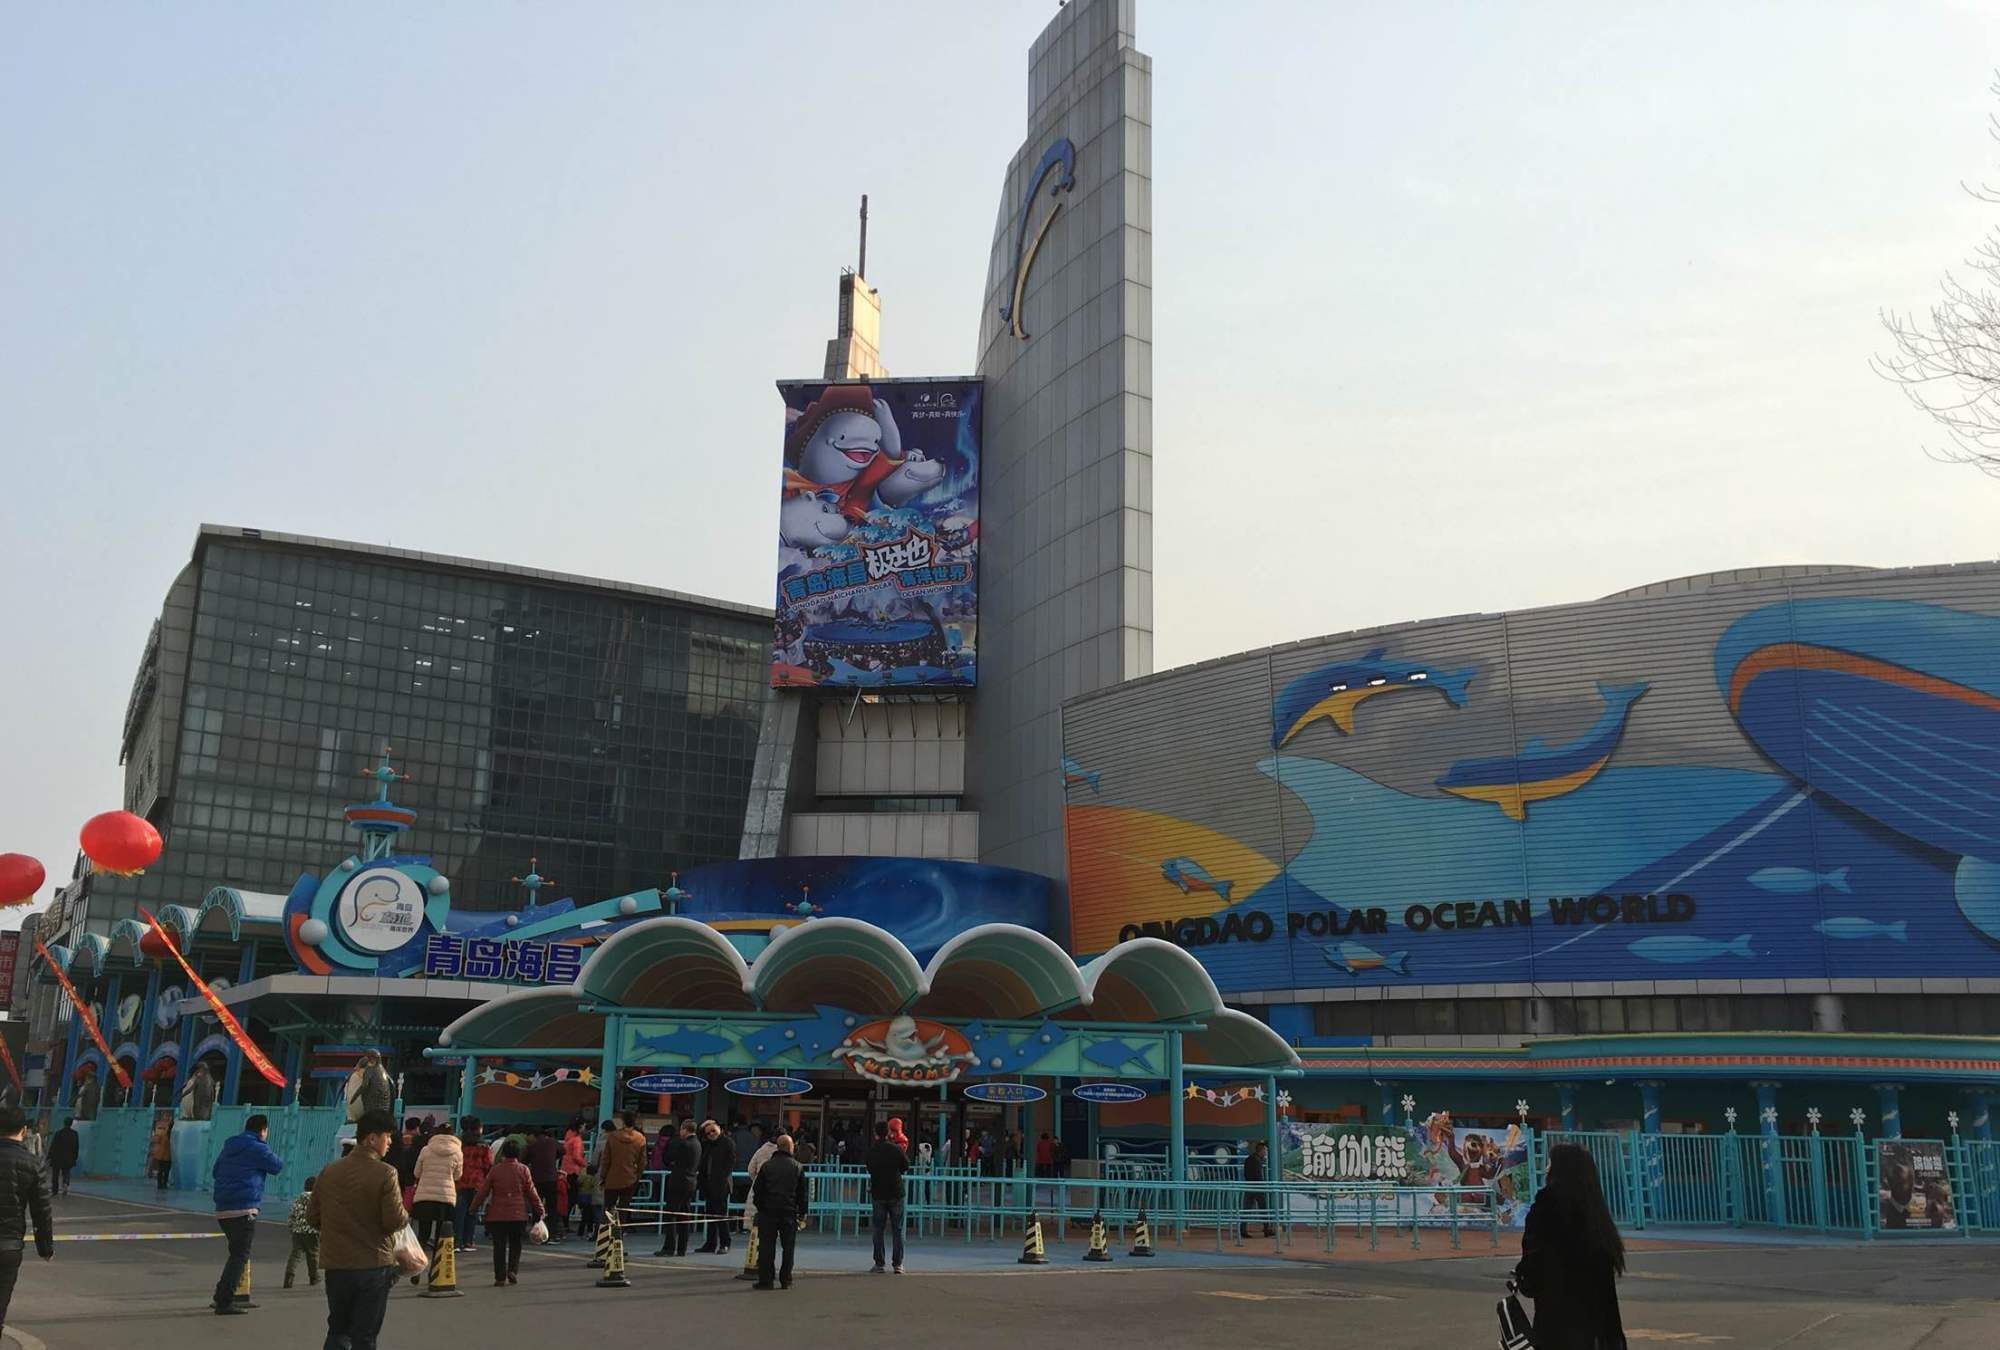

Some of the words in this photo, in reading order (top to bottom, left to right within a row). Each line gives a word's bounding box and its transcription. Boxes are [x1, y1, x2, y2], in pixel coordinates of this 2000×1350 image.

[785, 561, 867, 600] 青岛海昌
[865, 534, 931, 580] 极地
[901, 564, 966, 587] 海洋世界
[791, 597, 826, 611] QINGDAO
[828, 586, 868, 601] HAICHANG
[869, 580, 893, 591] POLAR
[902, 589, 927, 599] OCEAN
[928, 584, 953, 595] WORLD
[1287, 907, 1389, 938] POLAR
[1404, 898, 1531, 933] OCEAN
[1548, 894, 1697, 926] WORLD
[424, 933, 584, 985] 青岛海昌
[863, 1057, 951, 1082] WELCOME
[1301, 1132, 1408, 1178] 瑜伽熊
